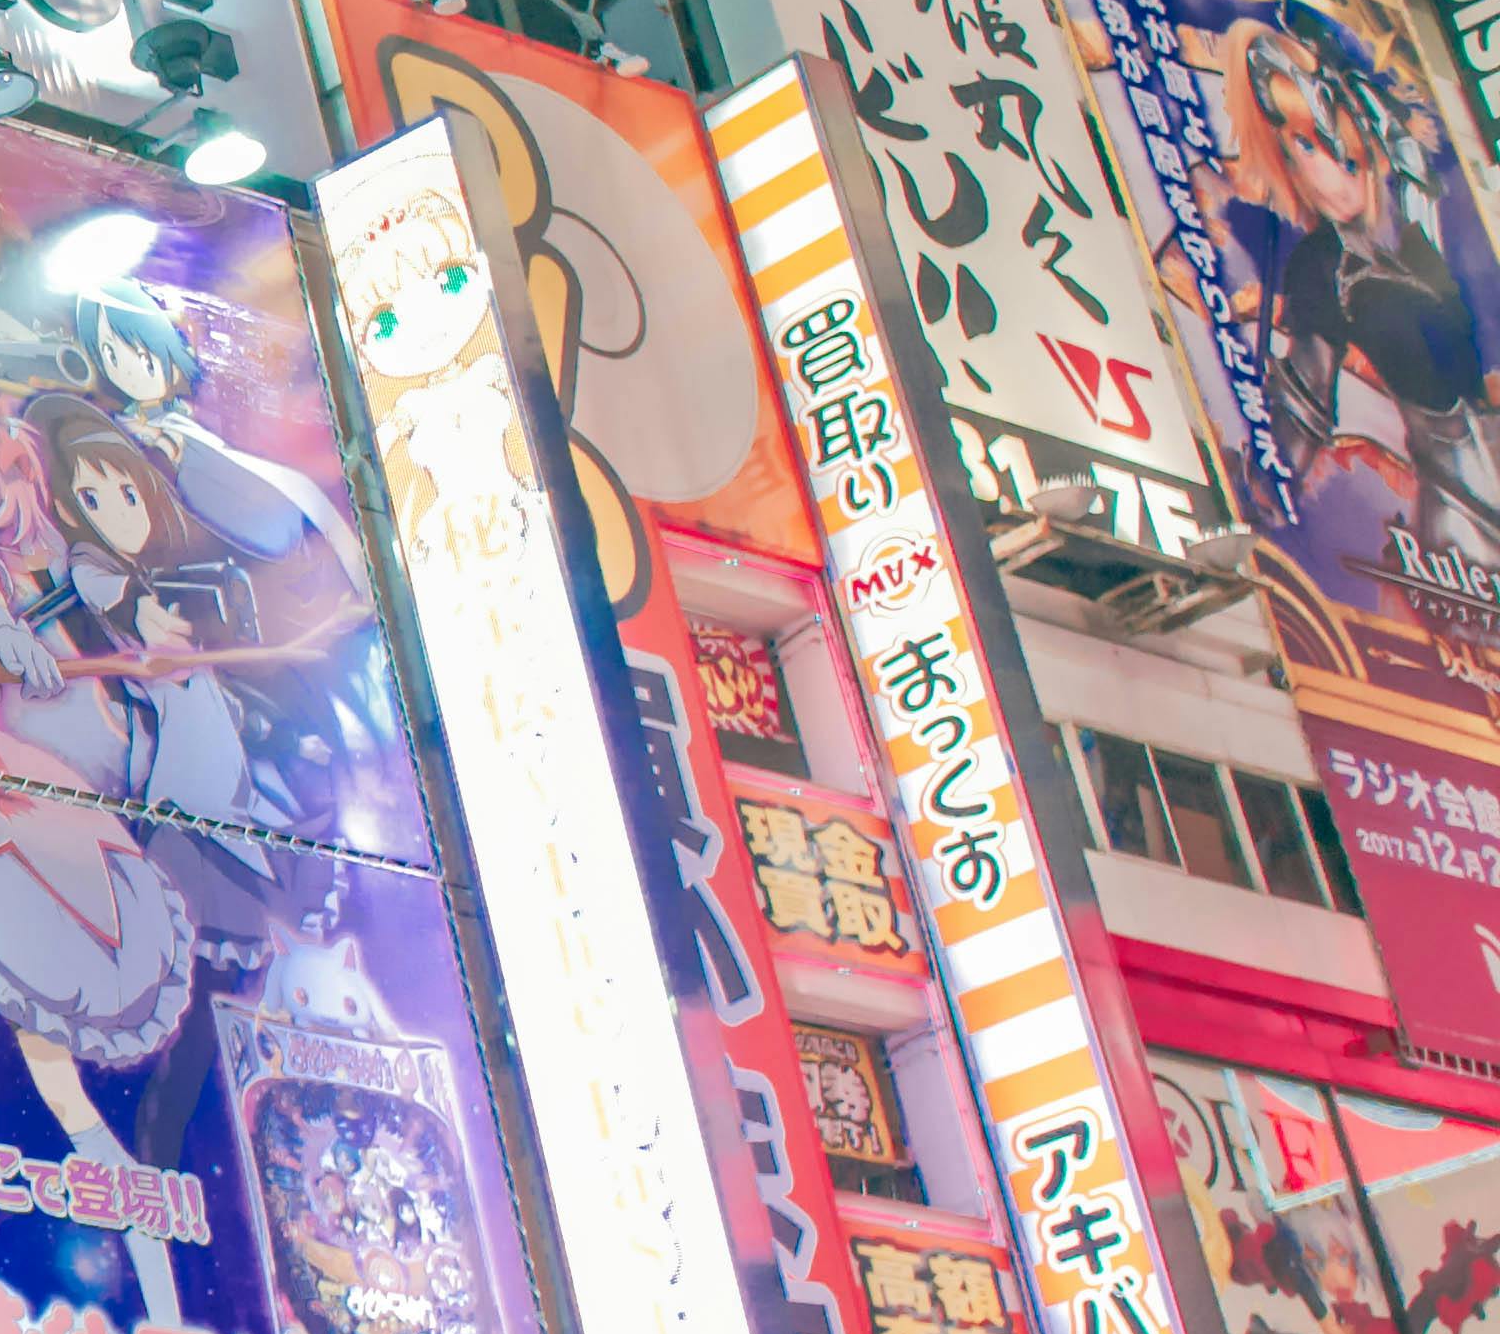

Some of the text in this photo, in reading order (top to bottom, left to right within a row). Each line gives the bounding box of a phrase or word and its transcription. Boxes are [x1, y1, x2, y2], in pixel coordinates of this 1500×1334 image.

[776, 296, 904, 523] 買取り
[876, 630, 1011, 909] まっくす
[739, 795, 884, 889] 現金
[758, 864, 909, 957] 買取
[850, 1239, 1008, 1331] 高額
